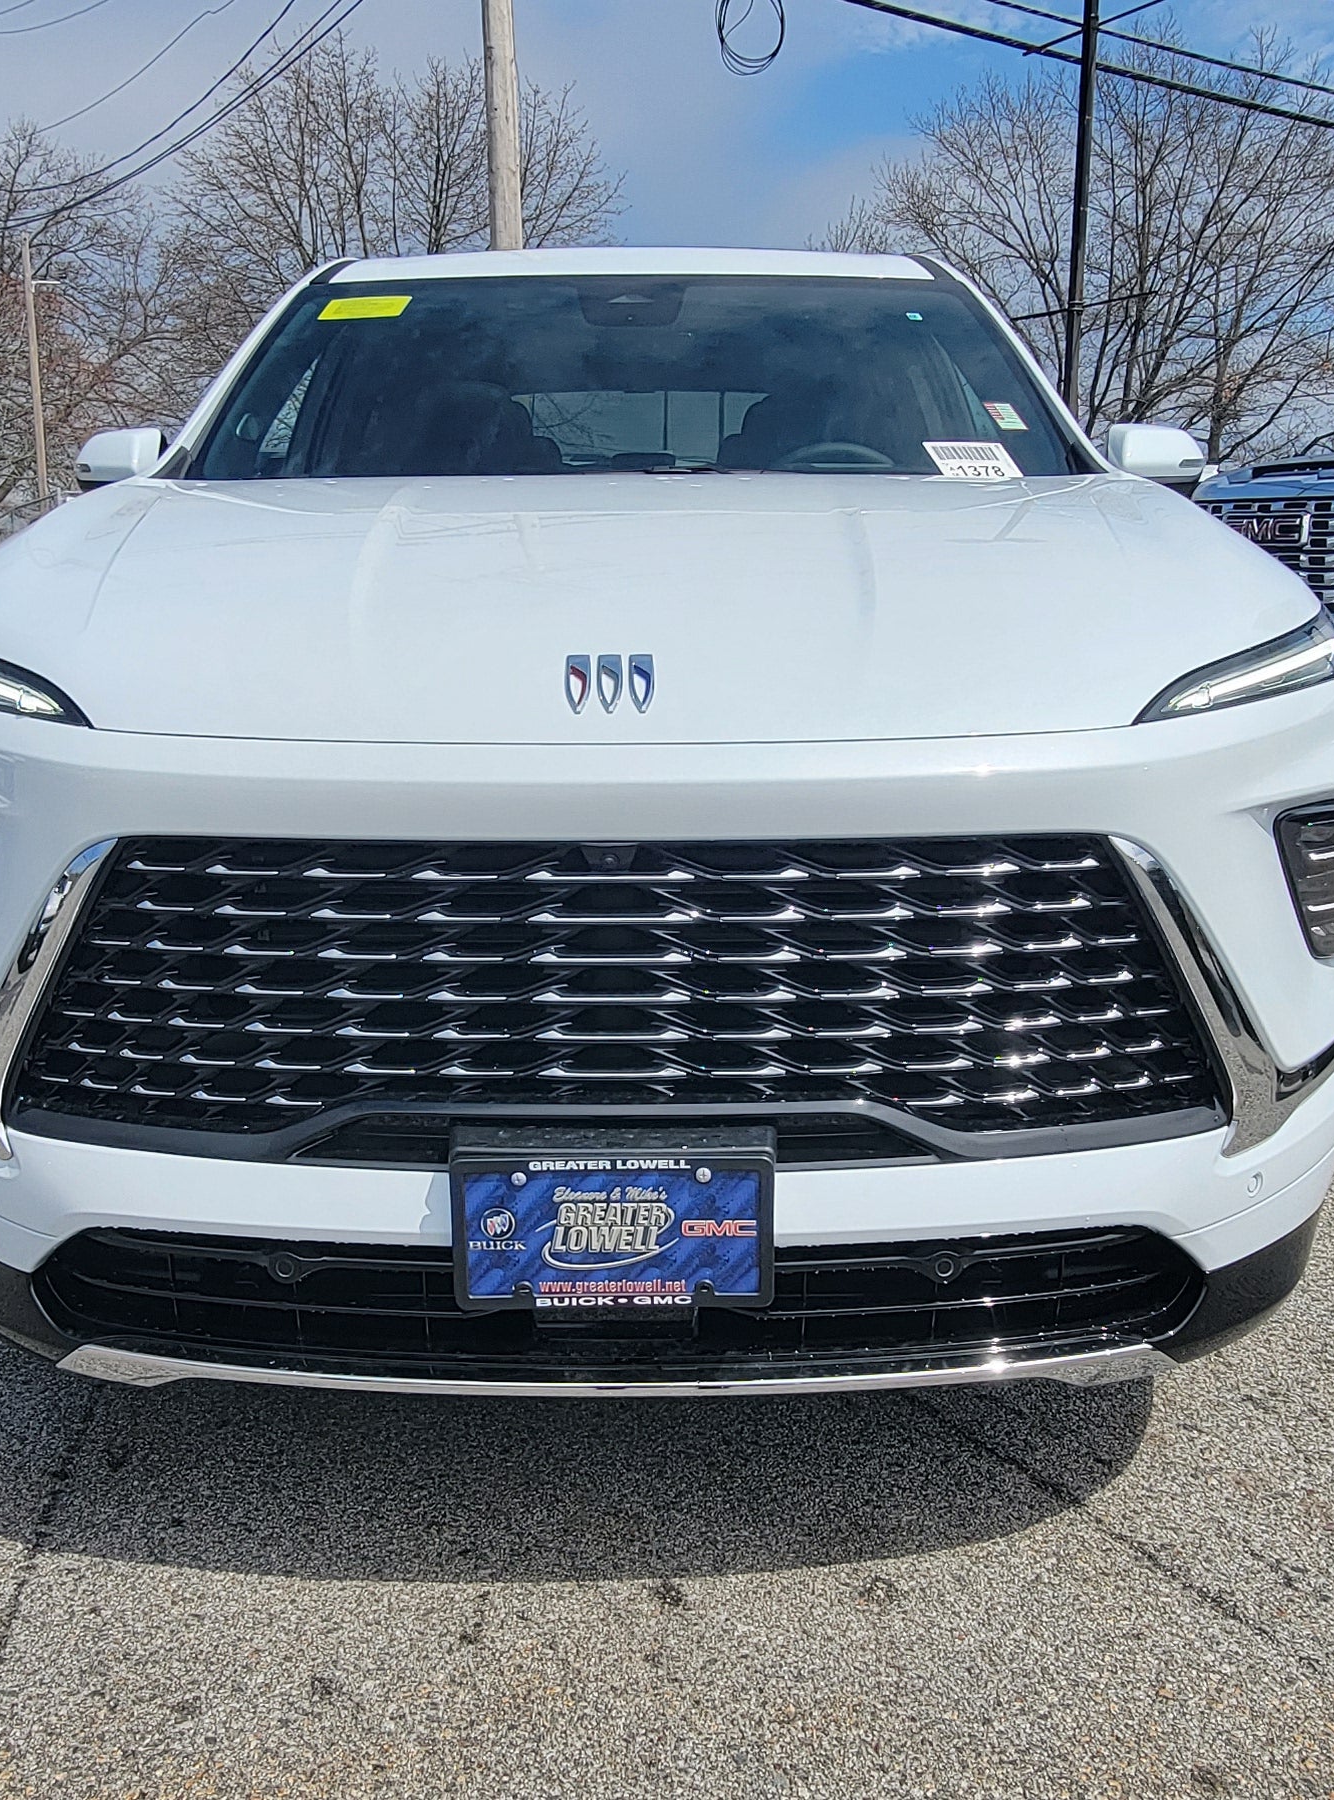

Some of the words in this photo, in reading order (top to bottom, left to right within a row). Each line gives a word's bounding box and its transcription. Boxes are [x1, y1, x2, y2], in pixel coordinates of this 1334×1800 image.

[957, 465, 1005, 477] 1378
[528, 1160, 611, 1171] GREATER
[616, 1159, 691, 1170] LOWELL
[610, 1186, 622, 1201] &
[624, 1186, 668, 1201] Mike's
[556, 1202, 668, 1227] GREATER
[681, 1219, 757, 1237] GMC
[468, 1240, 527, 1251] BUICK
[550, 1226, 660, 1253] LOWELL
[538, 1278, 687, 1294] www.greaterlowell.net
[535, 1296, 615, 1307] BUICK
[632, 1295, 693, 1306] GMC
